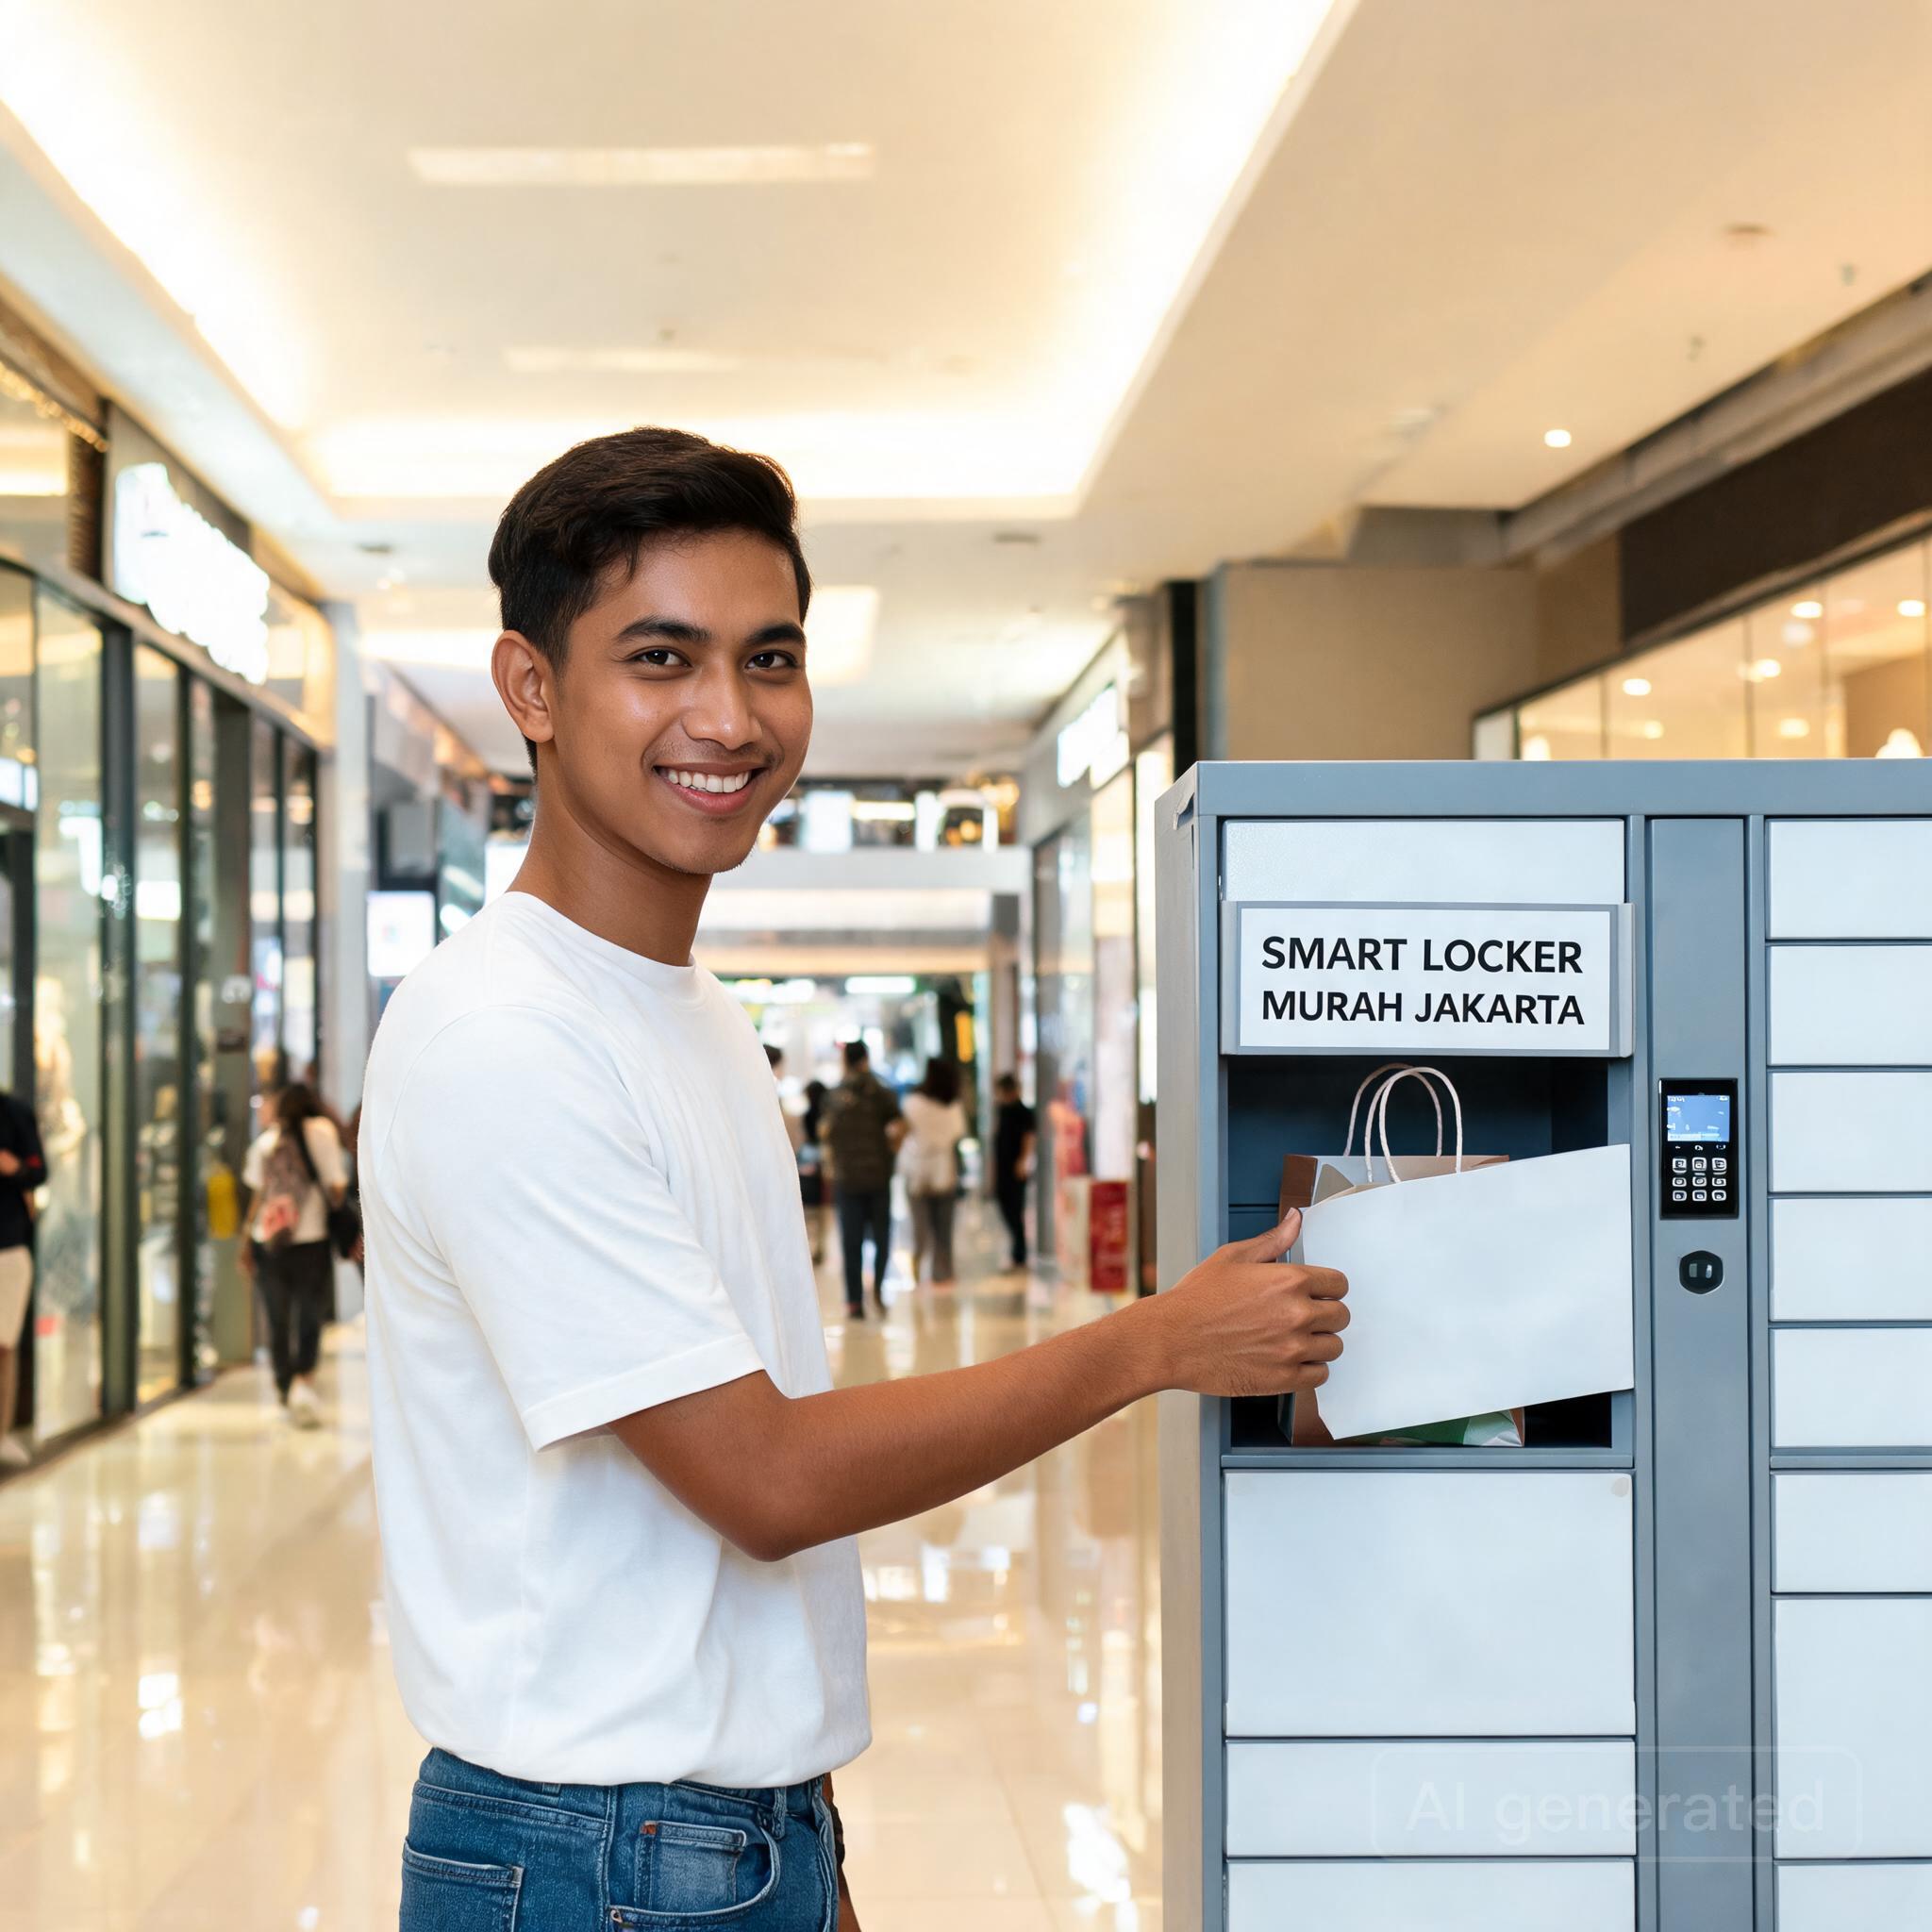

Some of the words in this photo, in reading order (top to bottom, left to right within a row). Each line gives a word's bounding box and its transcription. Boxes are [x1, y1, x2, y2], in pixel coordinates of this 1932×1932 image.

[1262, 937, 1407, 970] SMART
[1424, 940, 1582, 973] LOCKER
[1263, 991, 1402, 1022] MURAH
[1415, 993, 1584, 1024] JAKARTA
